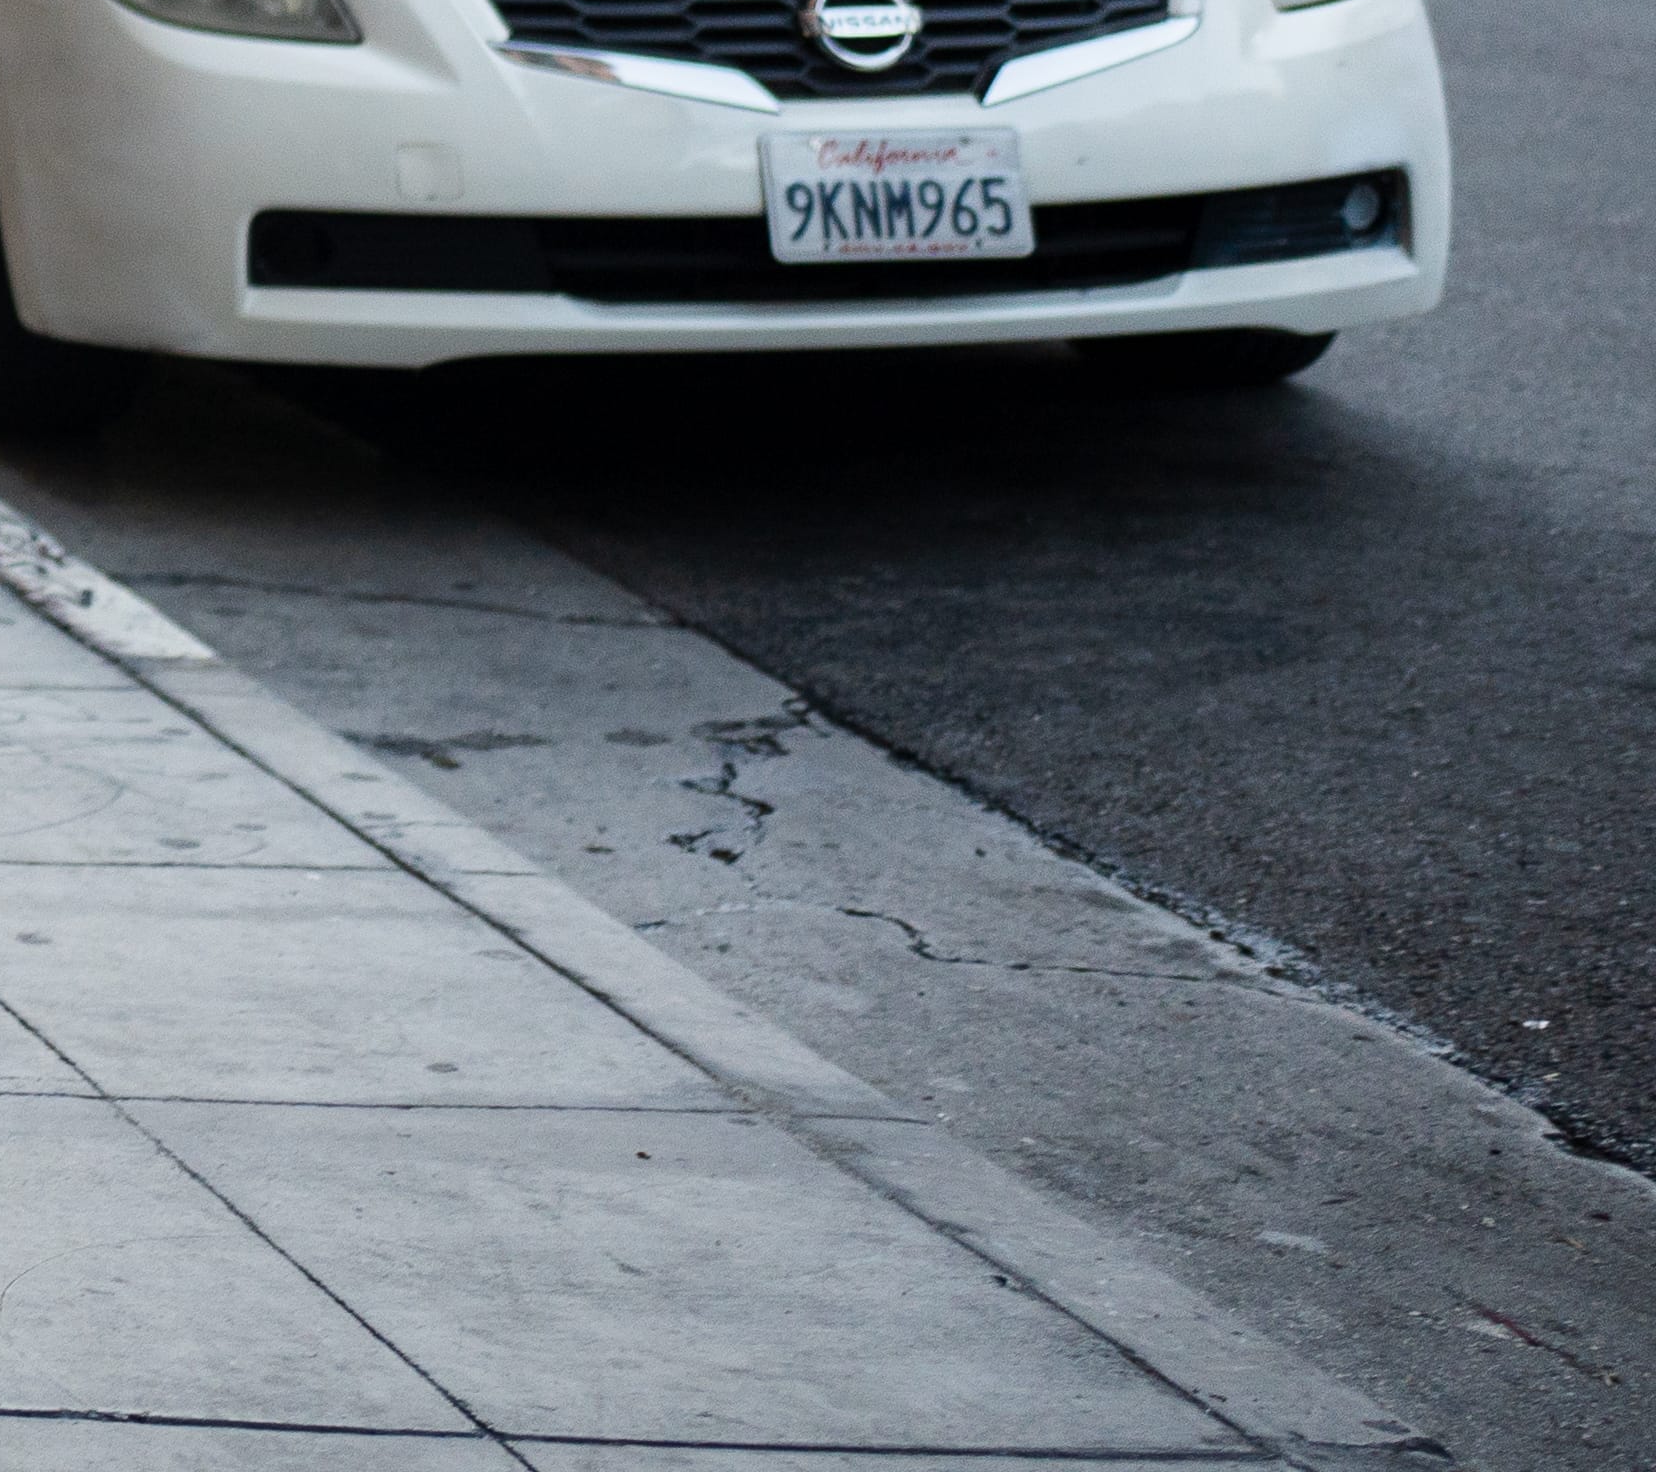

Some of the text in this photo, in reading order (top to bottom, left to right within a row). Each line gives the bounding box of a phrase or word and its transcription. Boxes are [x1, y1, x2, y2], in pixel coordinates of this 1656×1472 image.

[818, 13, 912, 30] NISSAN
[816, 136, 960, 174] California
[784, 175, 1014, 243] 9KNM965
